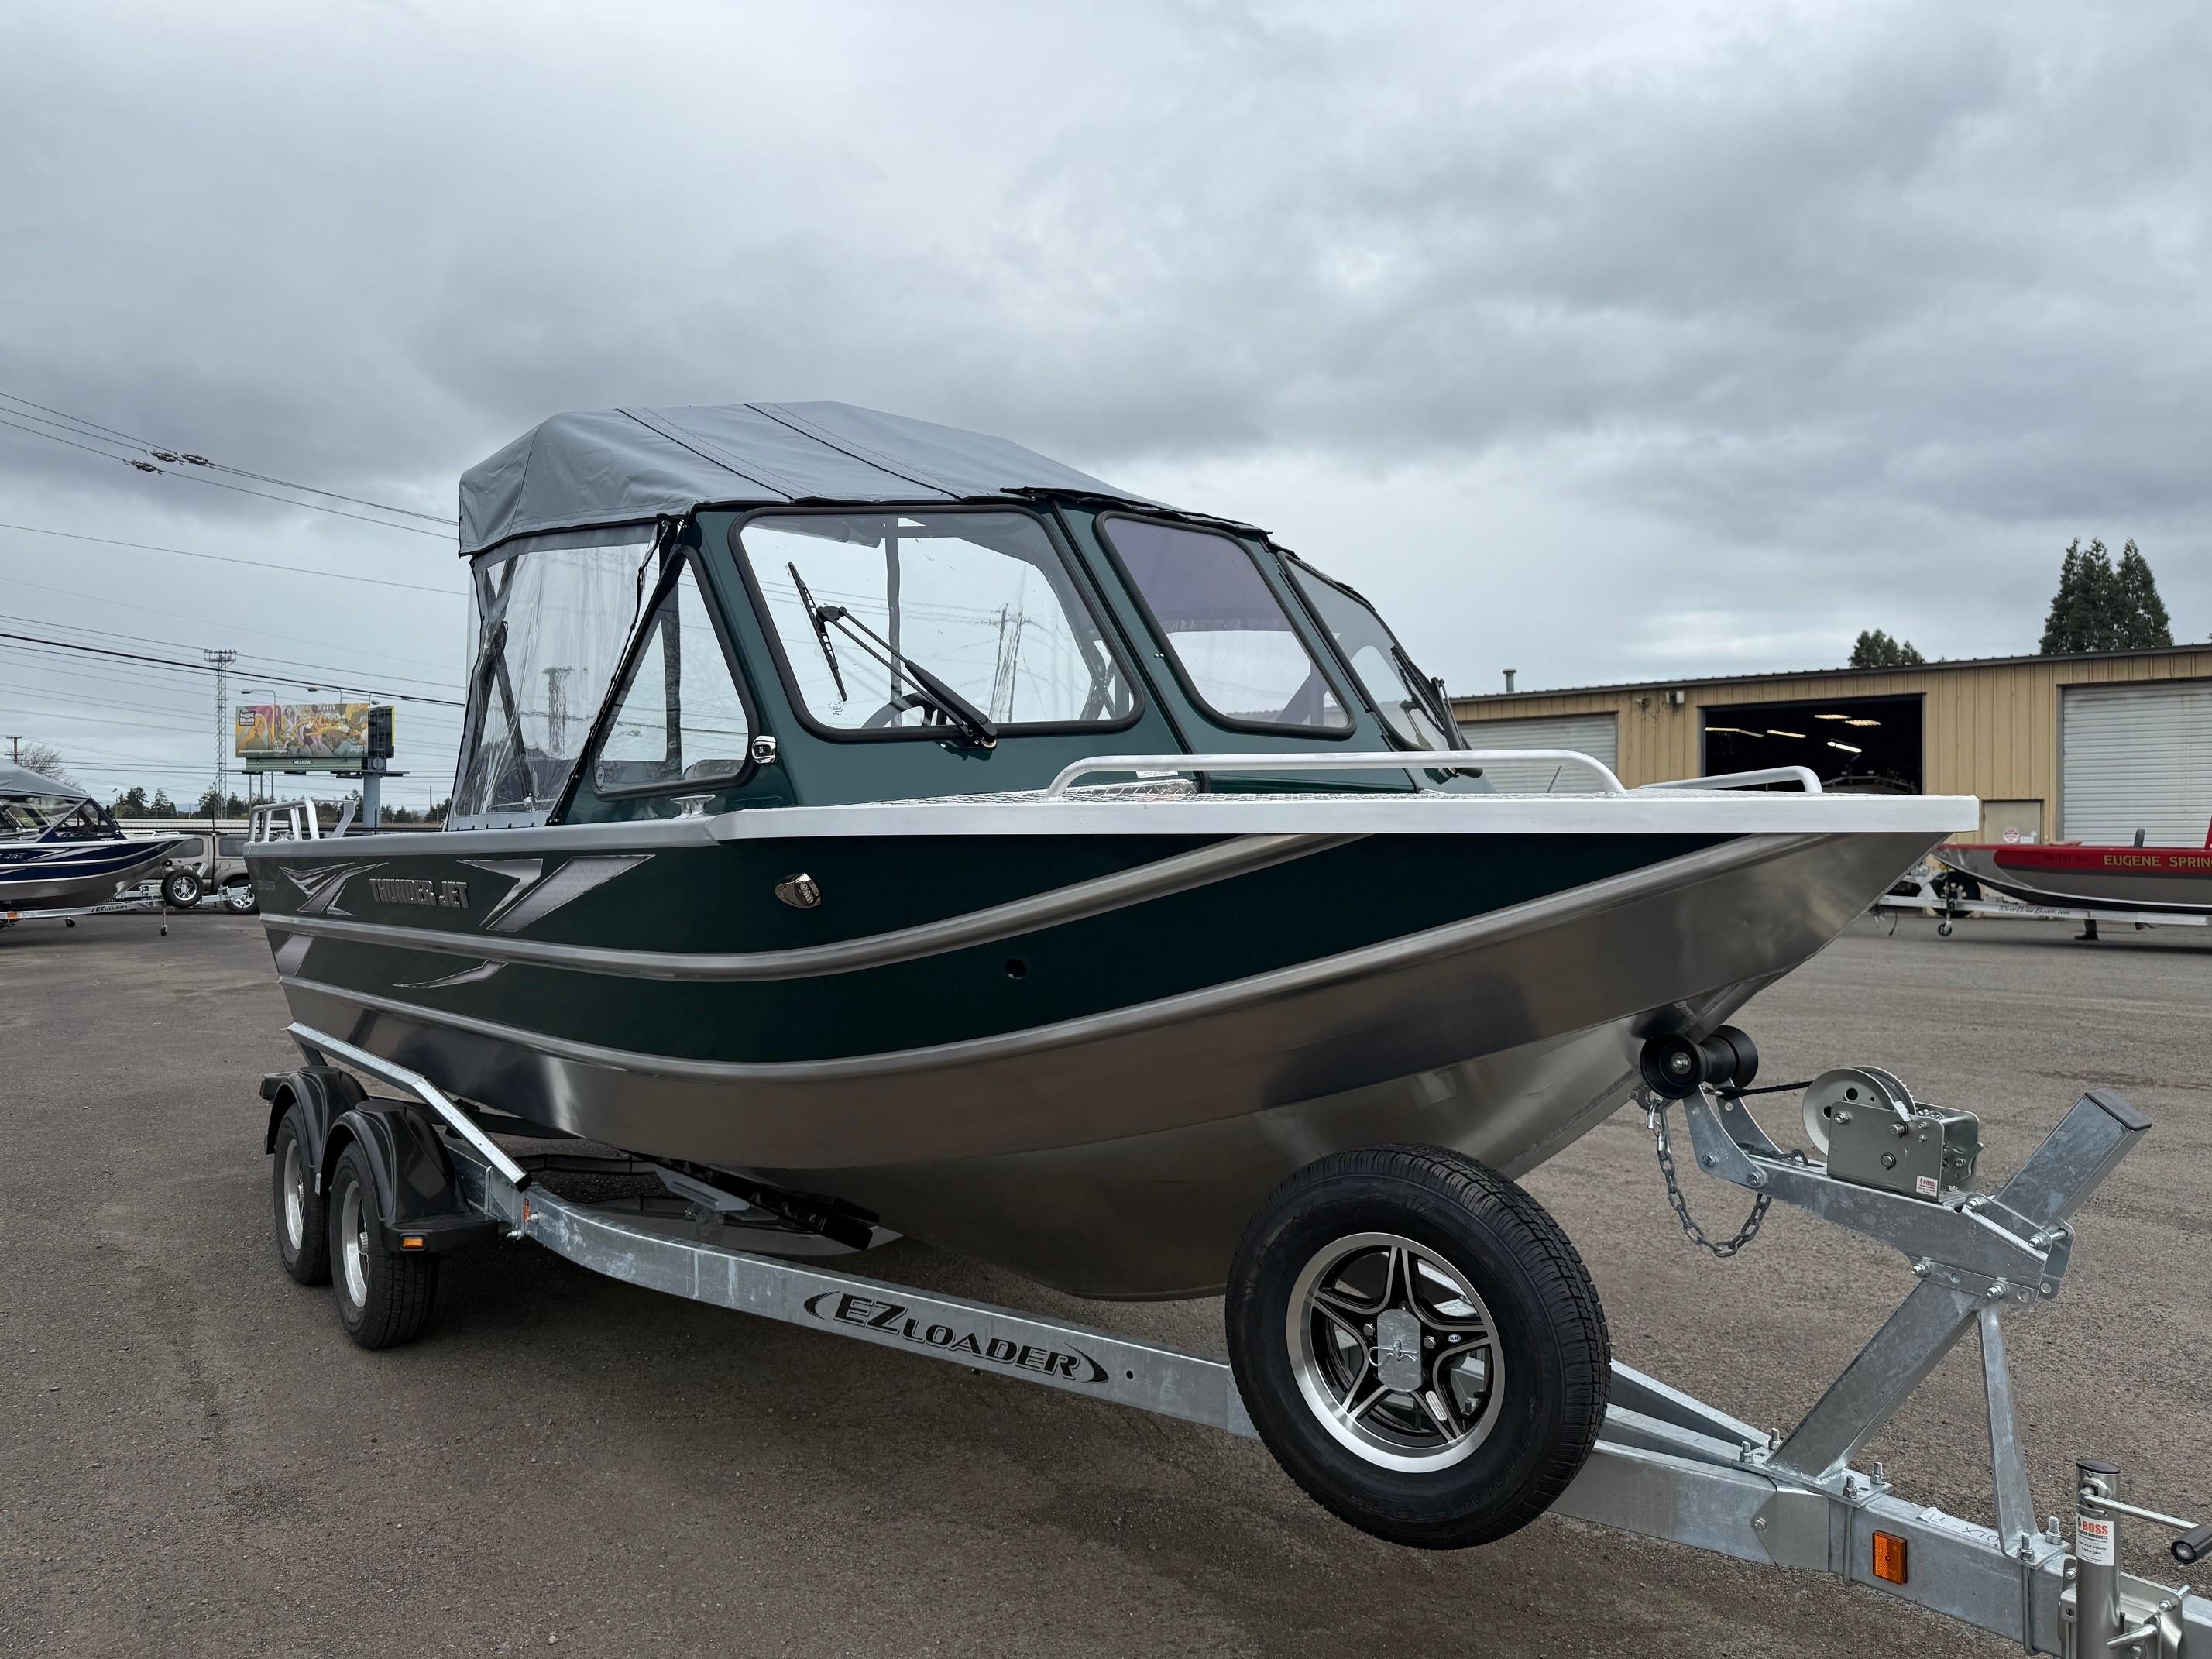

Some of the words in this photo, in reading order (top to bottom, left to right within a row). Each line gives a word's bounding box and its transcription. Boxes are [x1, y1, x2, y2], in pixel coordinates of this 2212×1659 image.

[2103, 854, 2162, 867] EUGENE
[2169, 856, 2212, 867] SPRIN
[369, 878, 437, 906] THUNDER
[438, 881, 469, 909] JET
[2082, 1520, 2108, 1535] BOSS
